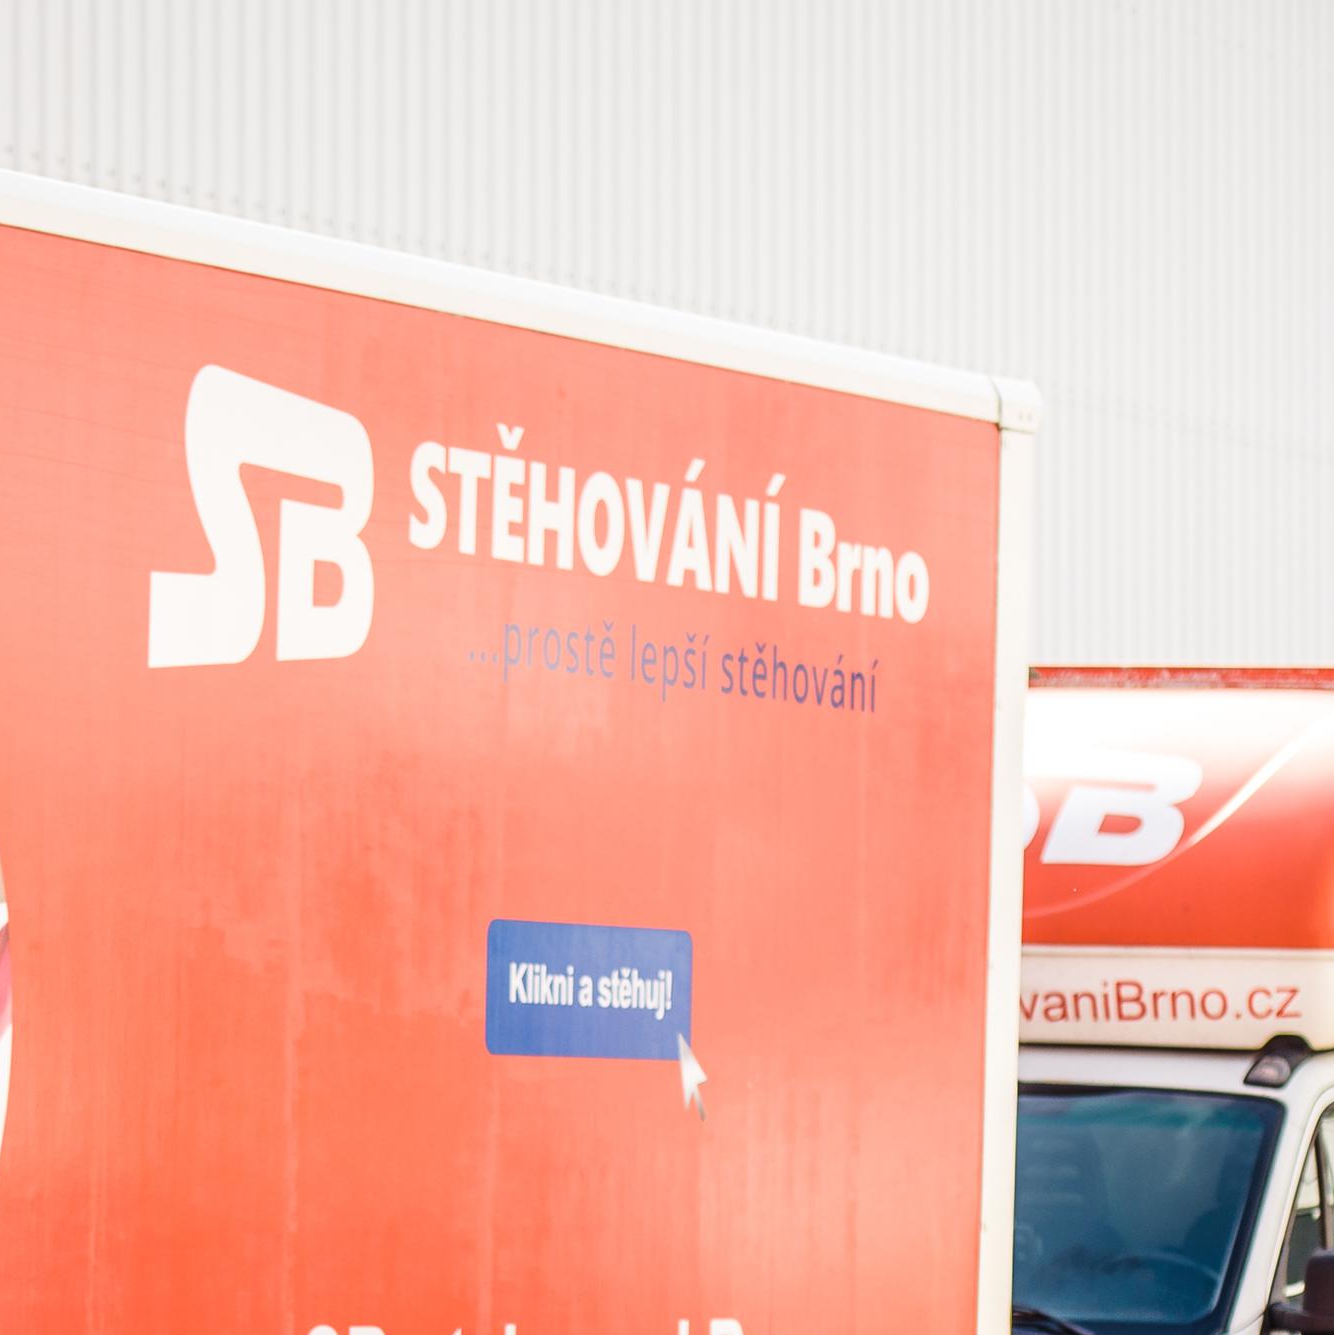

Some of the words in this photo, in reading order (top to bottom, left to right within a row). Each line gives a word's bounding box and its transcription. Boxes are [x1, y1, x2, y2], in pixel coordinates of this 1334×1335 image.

[148, 363, 375, 668] SB
[408, 422, 787, 602] STĚHOVÁNÍ
[798, 508, 931, 624] Brno
[630, 624, 710, 702] lepší
[720, 642, 879, 713] stěhování
[509, 962, 575, 1006] Klikni
[578, 975, 593, 1007] a
[597, 967, 673, 1020] stěhuj!
